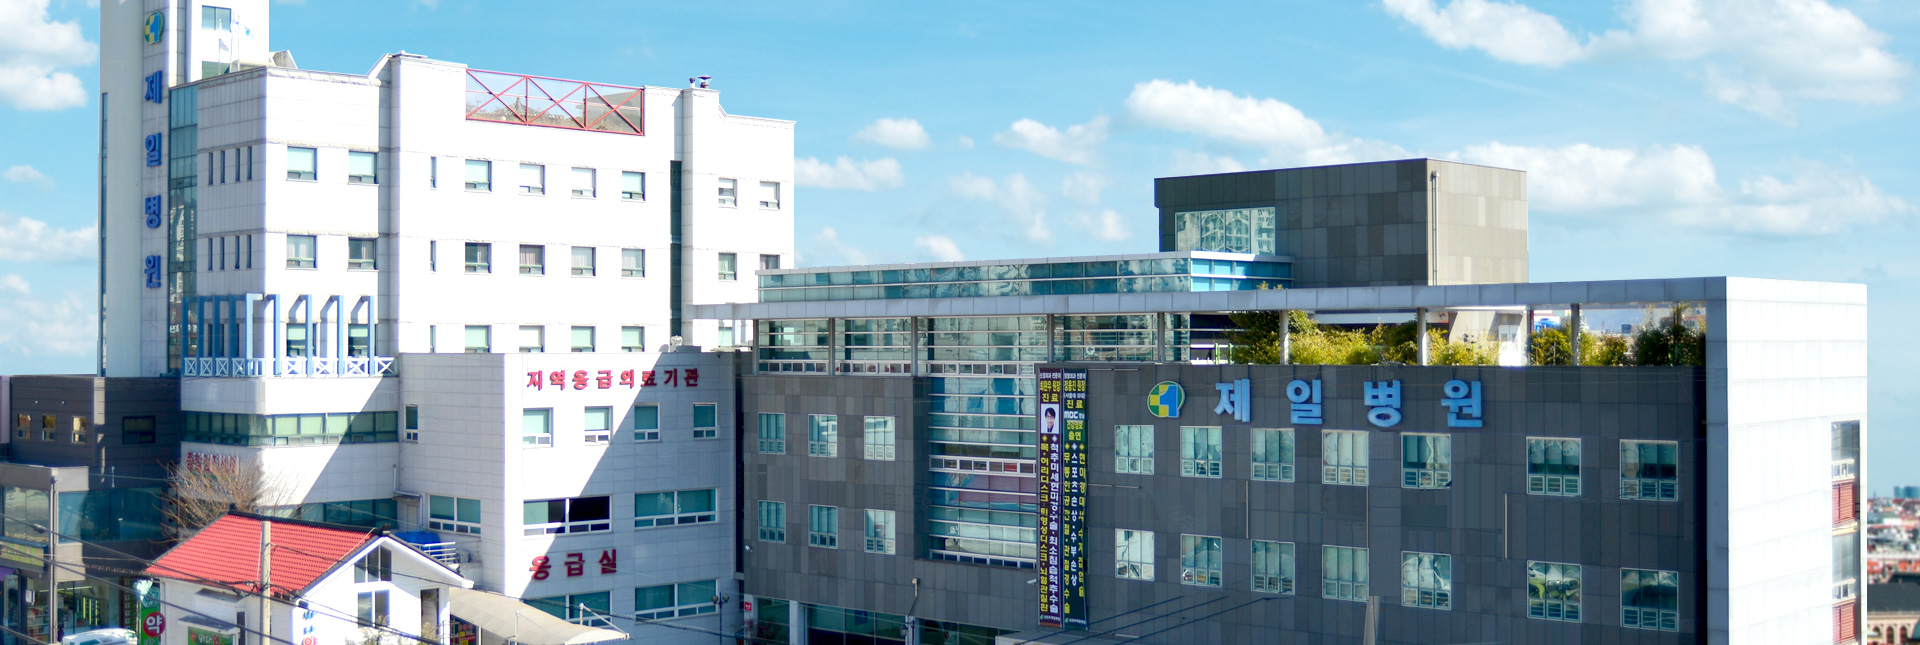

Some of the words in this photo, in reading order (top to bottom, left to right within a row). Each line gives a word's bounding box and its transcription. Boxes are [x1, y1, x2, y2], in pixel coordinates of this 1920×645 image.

[145, 70, 162, 288] 제일병원
[527, 368, 699, 391] 지역응급의료기관
[1213, 378, 1482, 428] 제일병원
[529, 549, 617, 580] 응급실
[146, 615, 163, 634] 약
